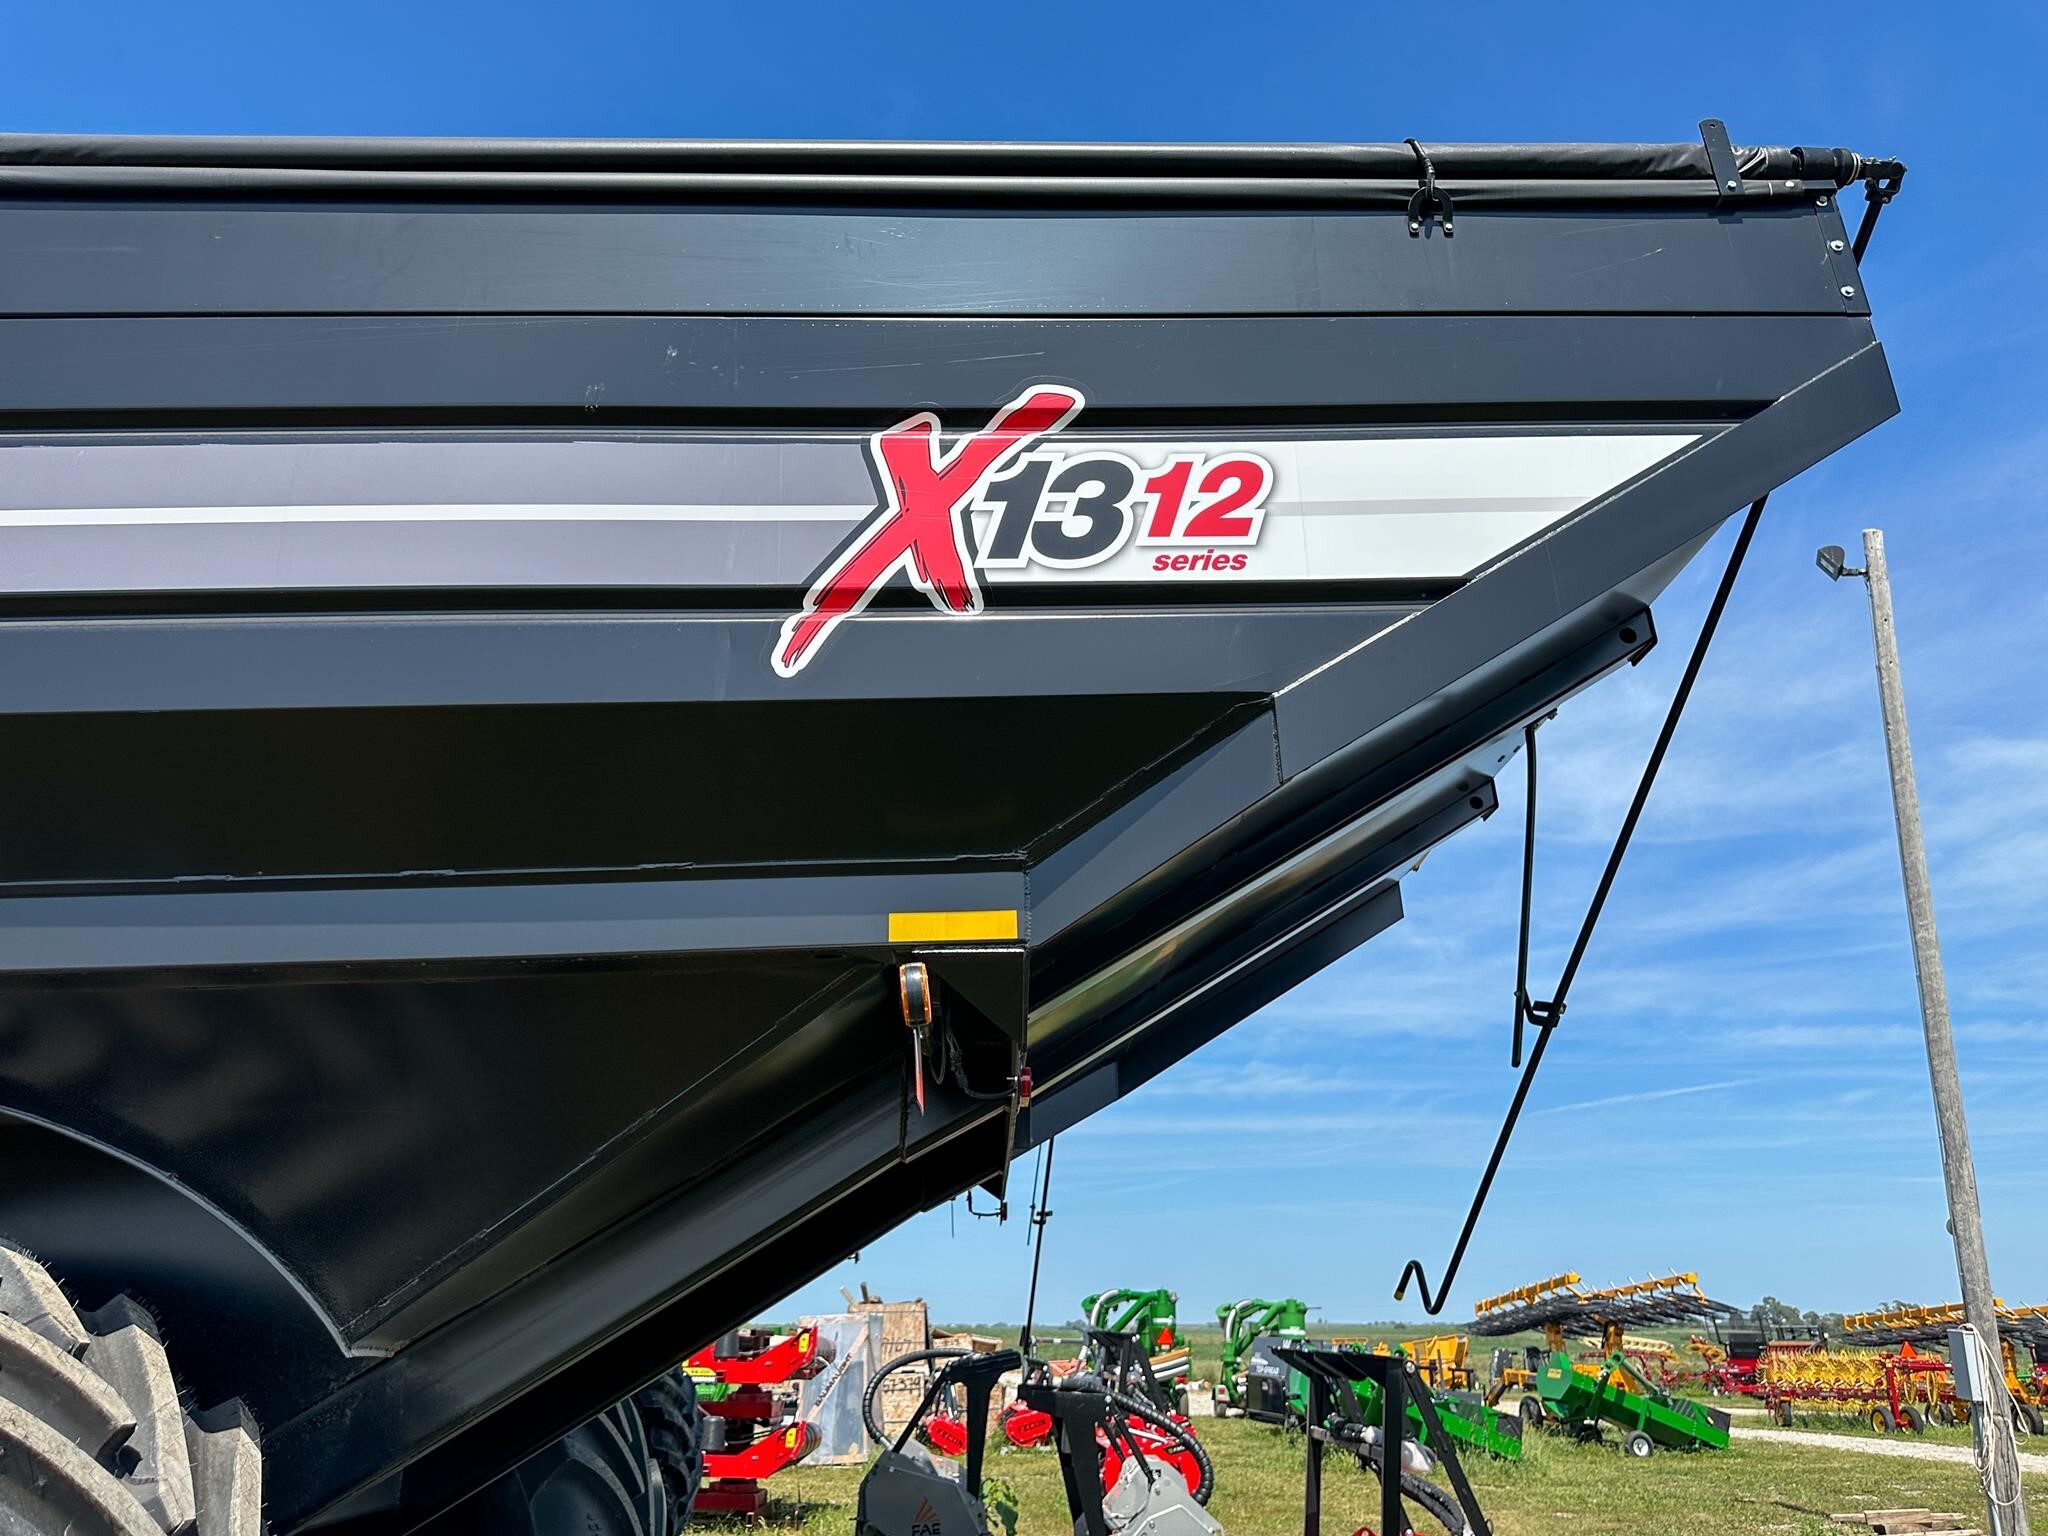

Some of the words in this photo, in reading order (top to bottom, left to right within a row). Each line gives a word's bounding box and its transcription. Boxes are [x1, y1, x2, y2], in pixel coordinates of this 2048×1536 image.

[1152, 548, 1248, 572] series
[1017, 1419, 1046, 1432] FECON
[912, 1523, 941, 1536] FAE
